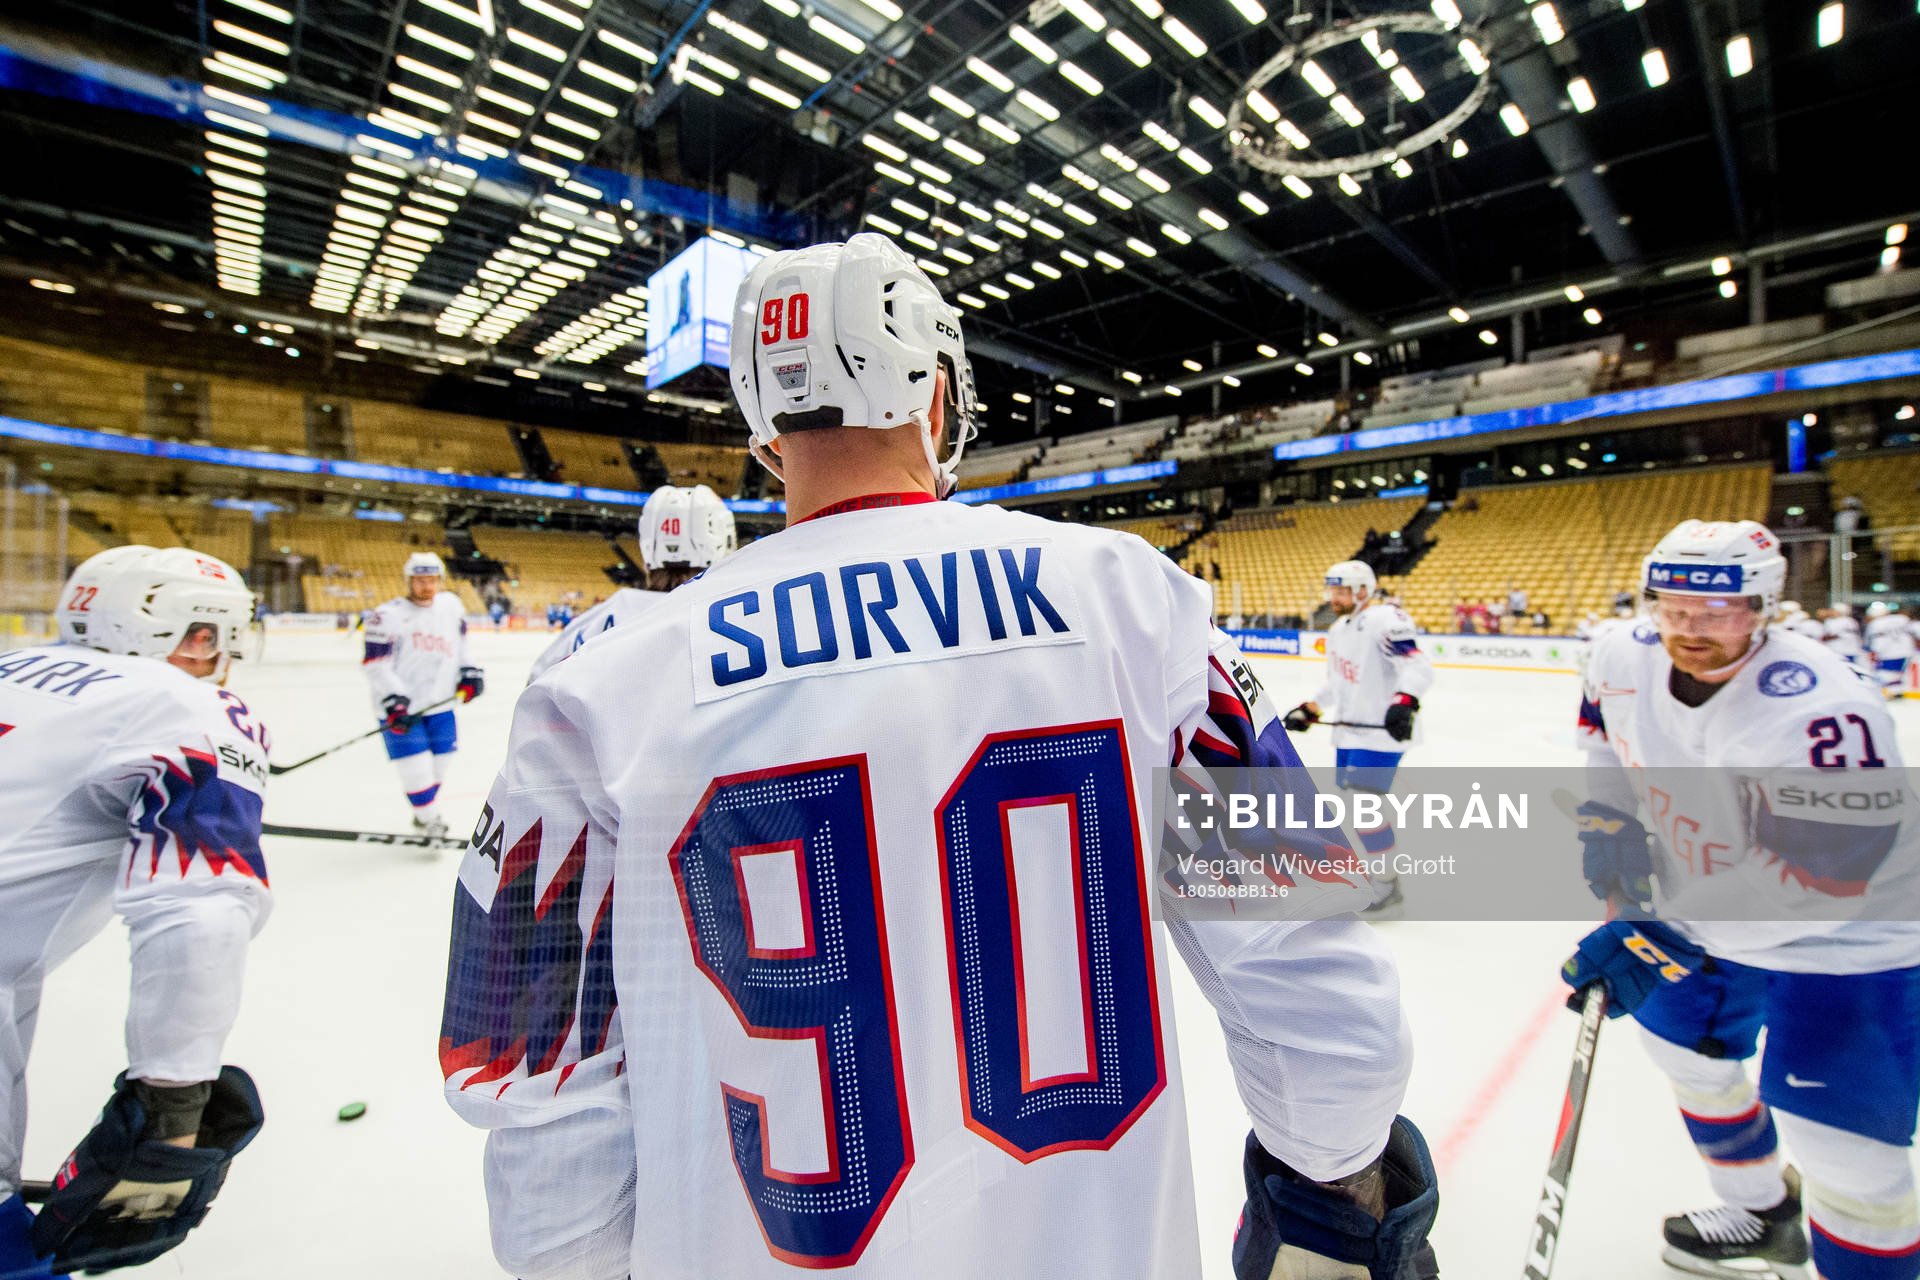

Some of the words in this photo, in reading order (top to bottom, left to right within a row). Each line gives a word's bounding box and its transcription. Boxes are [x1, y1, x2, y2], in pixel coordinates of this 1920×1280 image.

[761, 293, 810, 346] 90
[935, 319, 960, 343] CCM
[660, 517, 681, 536] 40
[66, 585, 99, 612] 22
[708, 546, 1071, 687] SORVIK
[0, 650, 123, 697] ARK
[1806, 713, 1887, 772] 21
[667, 717, 1168, 1271] 90
[1521, 1174, 1568, 1280] CM
